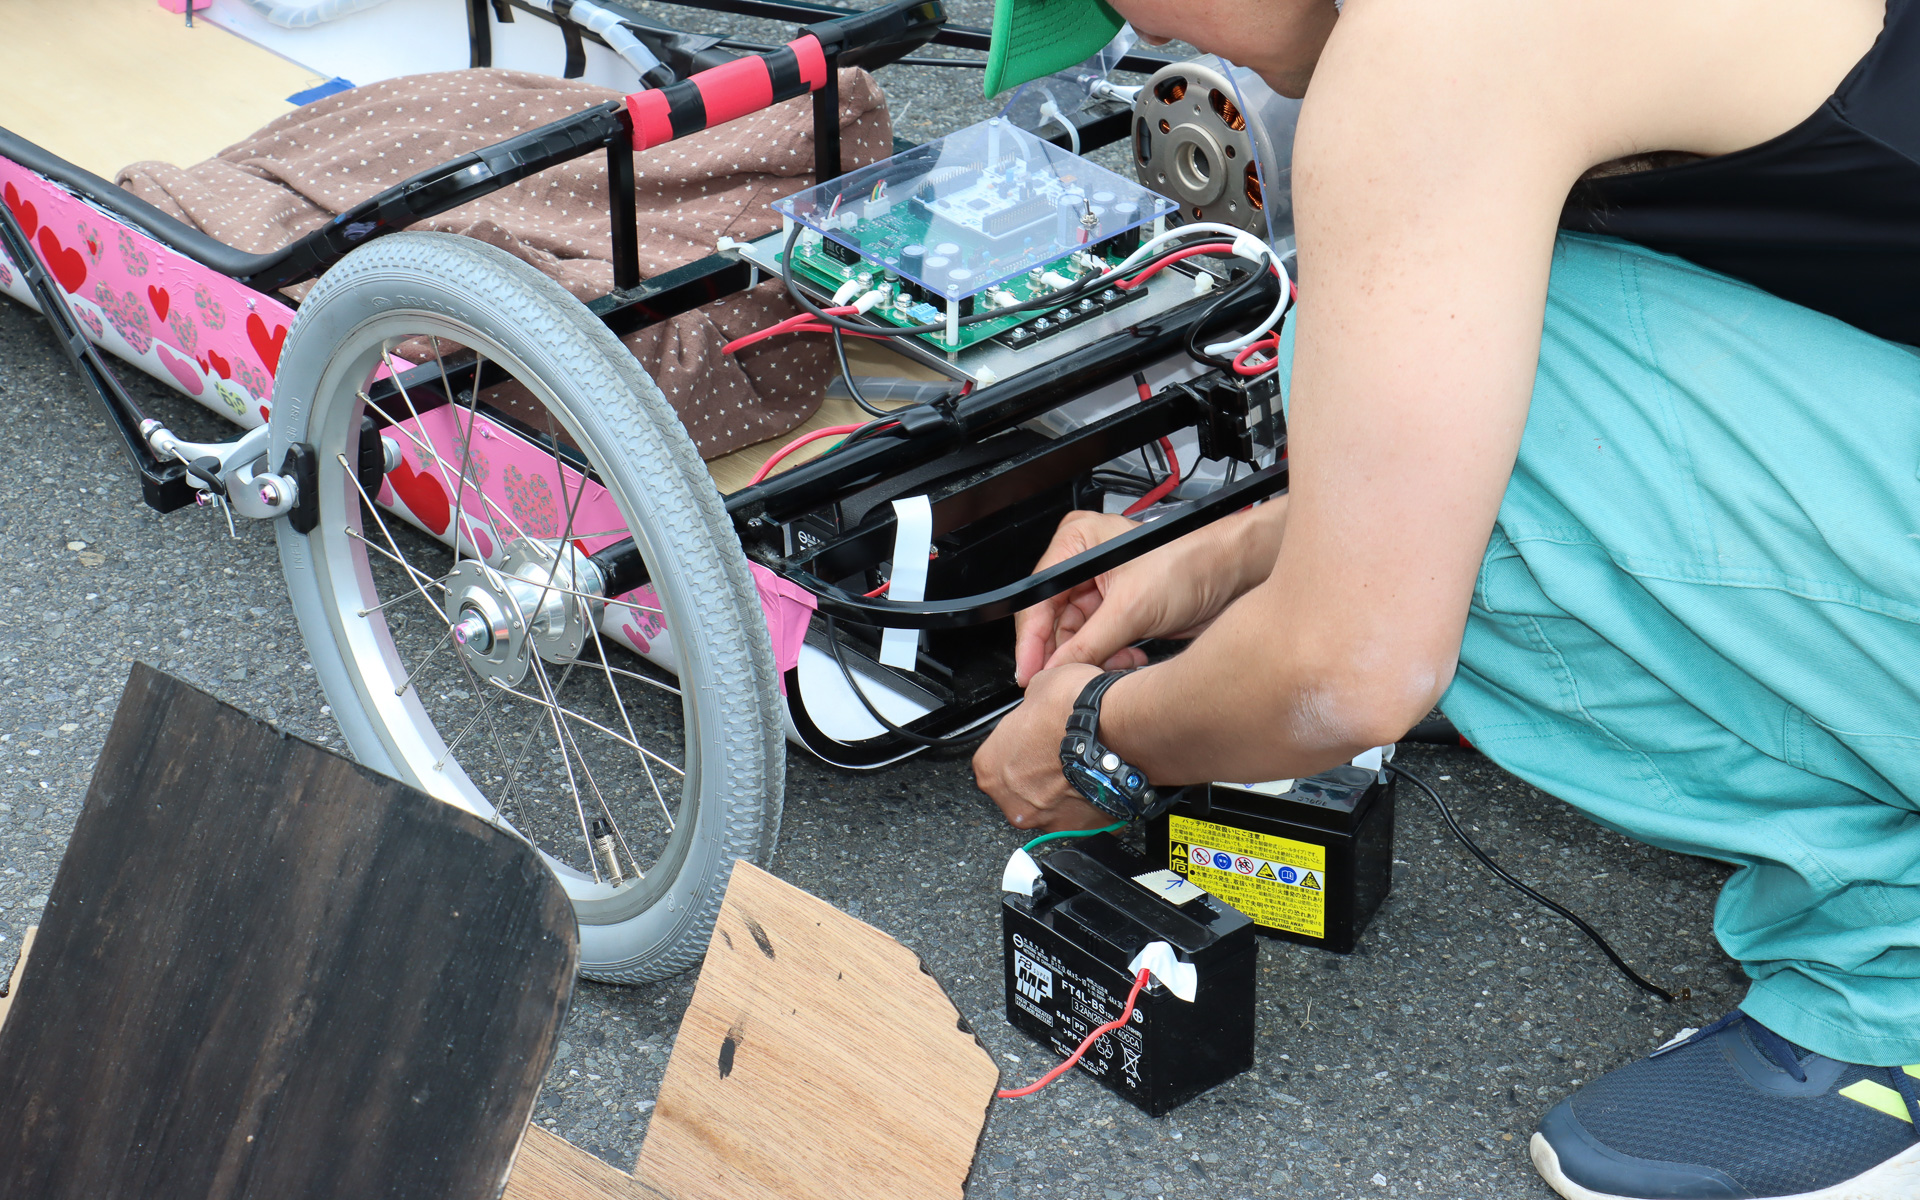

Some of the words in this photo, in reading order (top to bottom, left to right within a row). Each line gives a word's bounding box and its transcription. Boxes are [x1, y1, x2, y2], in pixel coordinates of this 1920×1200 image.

[1172, 858, 1187, 874] 危
[1061, 979, 1105, 1014] FT4L-BS
[1056, 1010, 1071, 1024] SAE
[1074, 1022, 1085, 1031] PP
[1099, 1059, 1109, 1070] Pb
[1126, 1076, 1136, 1088] Pb
